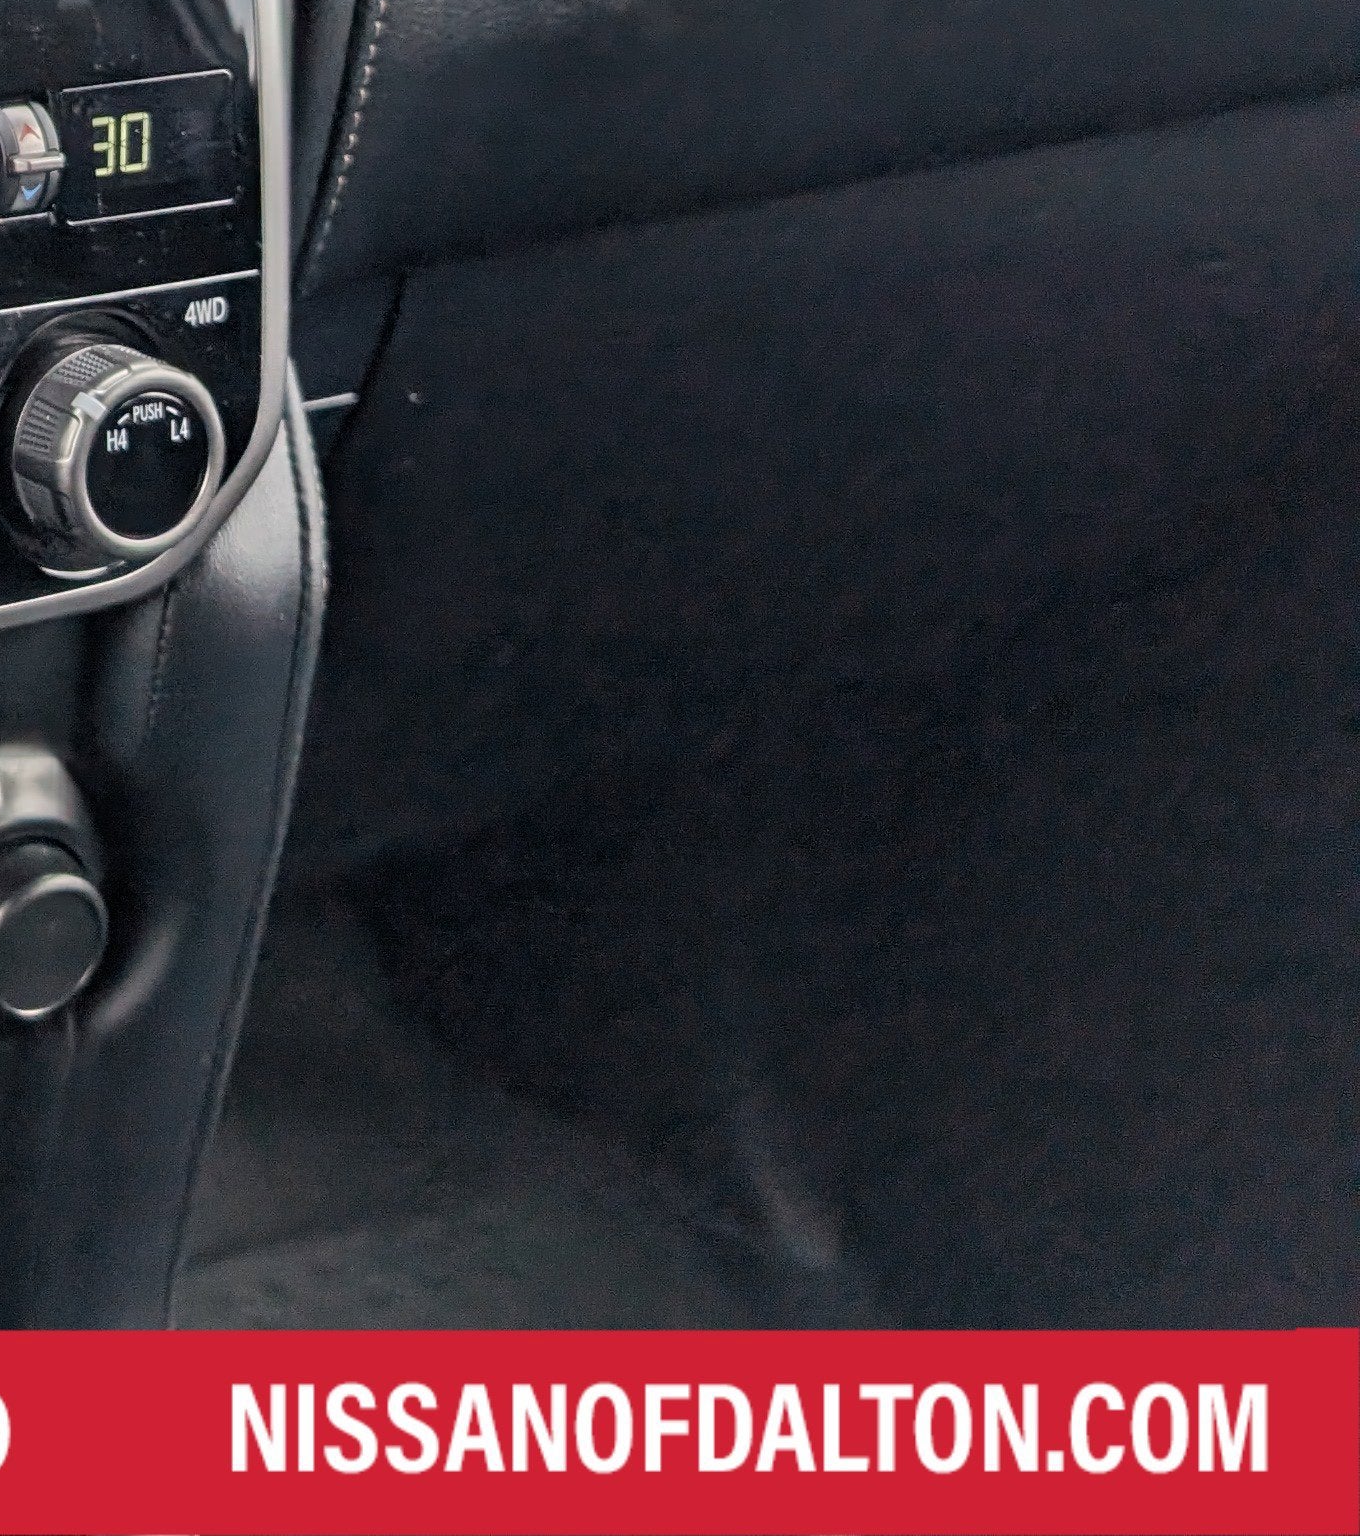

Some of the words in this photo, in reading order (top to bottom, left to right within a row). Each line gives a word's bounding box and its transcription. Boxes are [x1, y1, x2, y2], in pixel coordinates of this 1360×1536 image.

[185, 297, 227, 326] 4WD
[132, 402, 163, 424] PUSH
[106, 429, 129, 452] H4
[170, 417, 190, 441] L4
